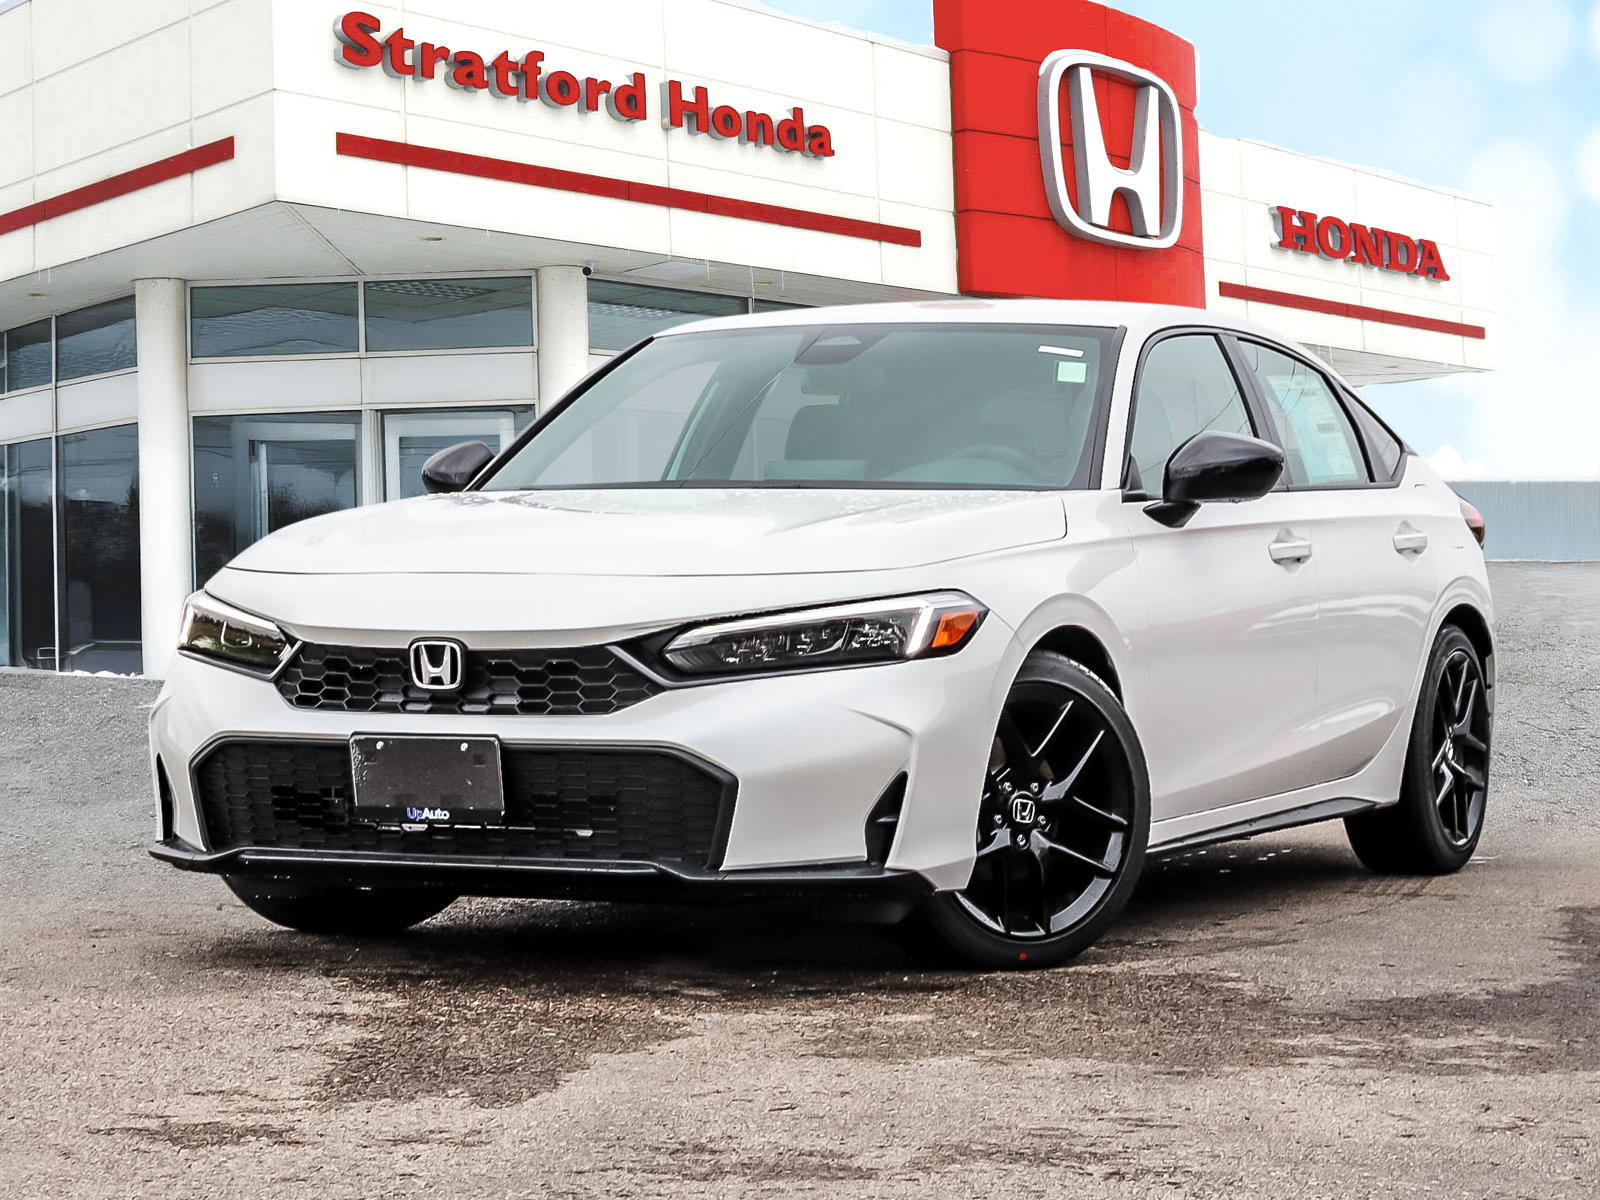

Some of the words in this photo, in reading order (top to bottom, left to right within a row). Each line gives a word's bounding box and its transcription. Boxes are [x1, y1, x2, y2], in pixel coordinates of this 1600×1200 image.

[335, 11, 647, 122] Stratford
[661, 78, 835, 159] Honda
[1270, 205, 1450, 281] HONDA
[406, 807, 450, 821] UpAuto
